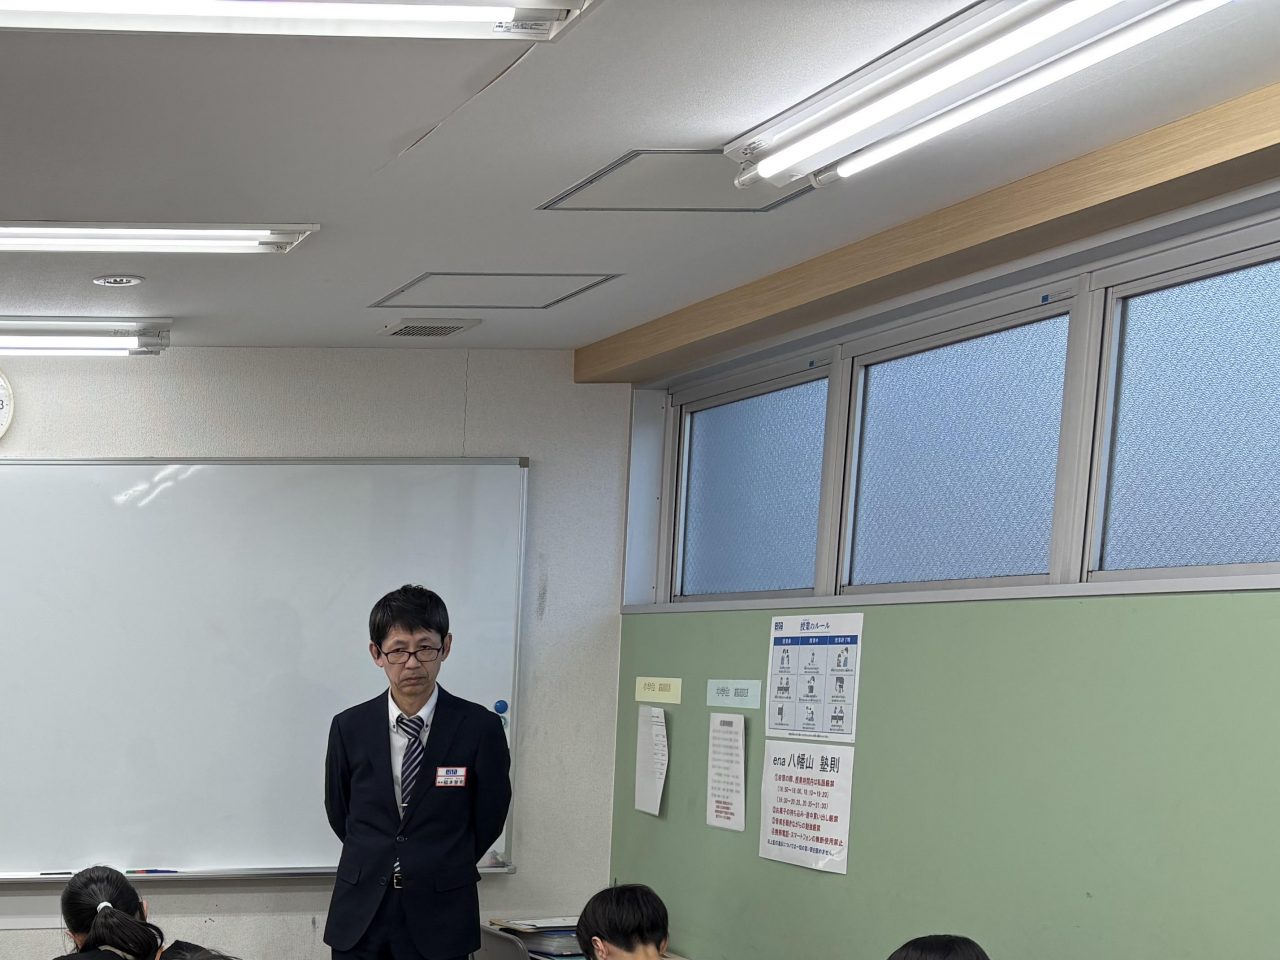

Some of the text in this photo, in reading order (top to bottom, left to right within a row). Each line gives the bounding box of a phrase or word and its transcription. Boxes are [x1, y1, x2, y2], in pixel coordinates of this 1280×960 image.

[772, 753, 841, 773] ena 八幡山 塾則
